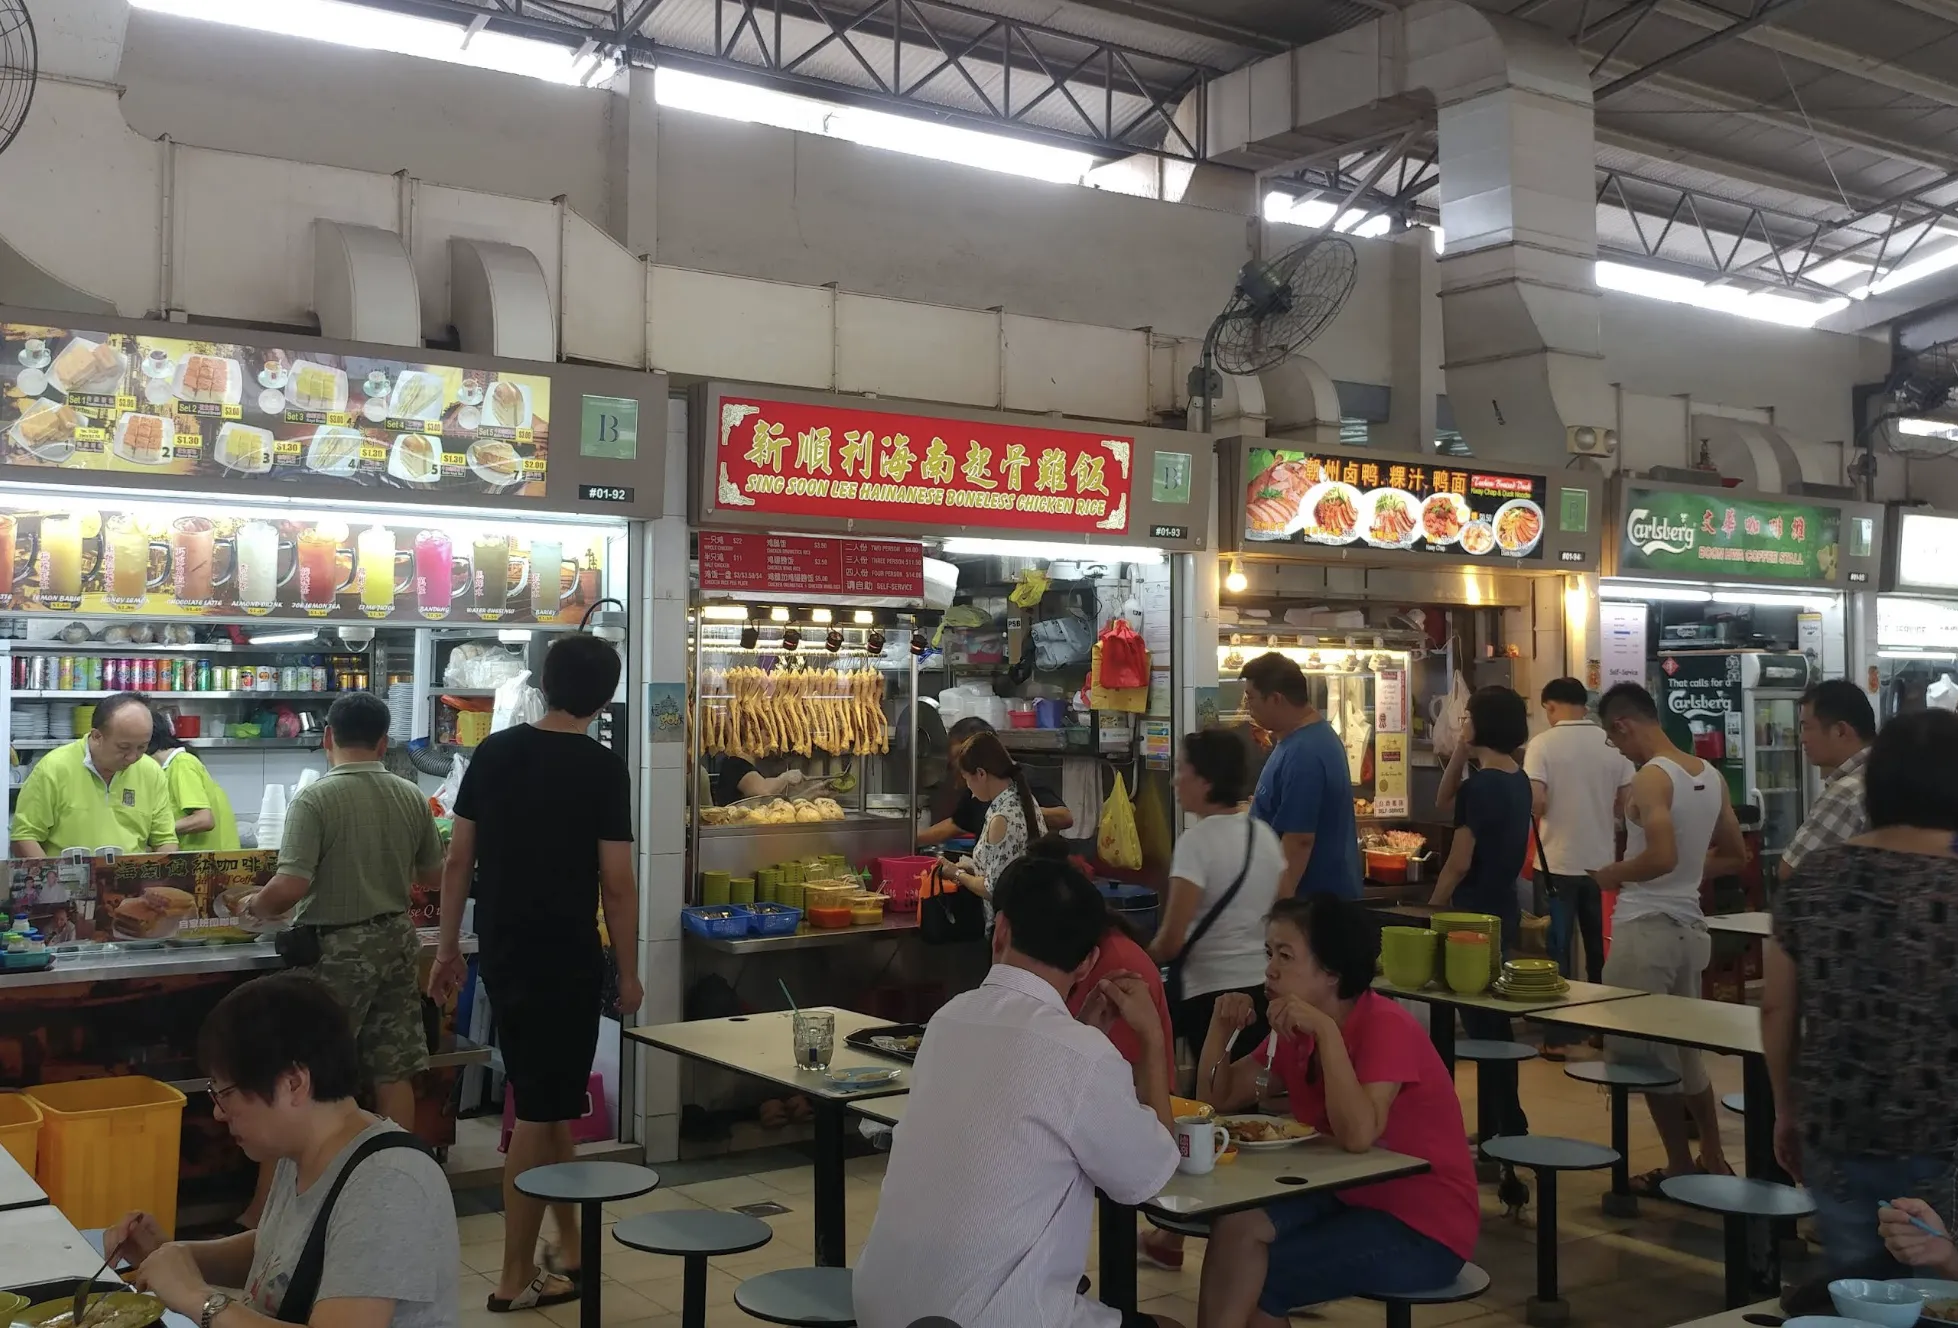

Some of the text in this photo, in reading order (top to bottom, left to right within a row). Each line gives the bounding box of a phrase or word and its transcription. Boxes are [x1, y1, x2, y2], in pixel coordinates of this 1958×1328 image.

[179, 403, 192, 412] Set
[192, 405, 197, 413] 2
[225, 407, 240, 416] $3.00
[287, 411, 298, 420] Set
[387, 420, 398, 428] Set
[400, 421, 405, 429] 4
[598, 414, 619, 442] B
[479, 428, 489, 436] Set
[489, 429, 494, 437] 5
[177, 436, 199, 445] $1.30
[161, 446, 171, 458] 2
[276, 443, 298, 451] $1.30
[262, 453, 270, 463] 3
[362, 449, 383, 458] $1.30
[348, 458, 356, 469] 4
[443, 455, 463, 463] $1.30
[431, 464, 438, 475] 5
[524, 460, 544, 469] $2.00
[513, 470, 520, 480] 7
[1164, 466, 1178, 489] B
[589, 487, 626, 500] #01-92
[745, 473, 1107, 517] SING SOON LEE HAINANESE BONELESS CHICKEN RICE
[1155, 526, 1181, 537] #01-93
[1627, 508, 1695, 552] Carlsberg
[733, 537, 743, 545] $22
[845, 543, 868, 552] 二人份
[733, 554, 743, 562] $11
[845, 555, 868, 565] 三人份
[1745, 549, 1779, 564] COFFEE
[1778, 551, 1804, 566] STALL
[845, 567, 868, 577] 四人份
[876, 582, 913, 591] SELF-SERVICE
[1668, 678, 1688, 687] That
[1689, 679, 1709, 687] calls
[1710, 679, 1724, 687] for
[1668, 690, 1732, 715] Carlsberg
